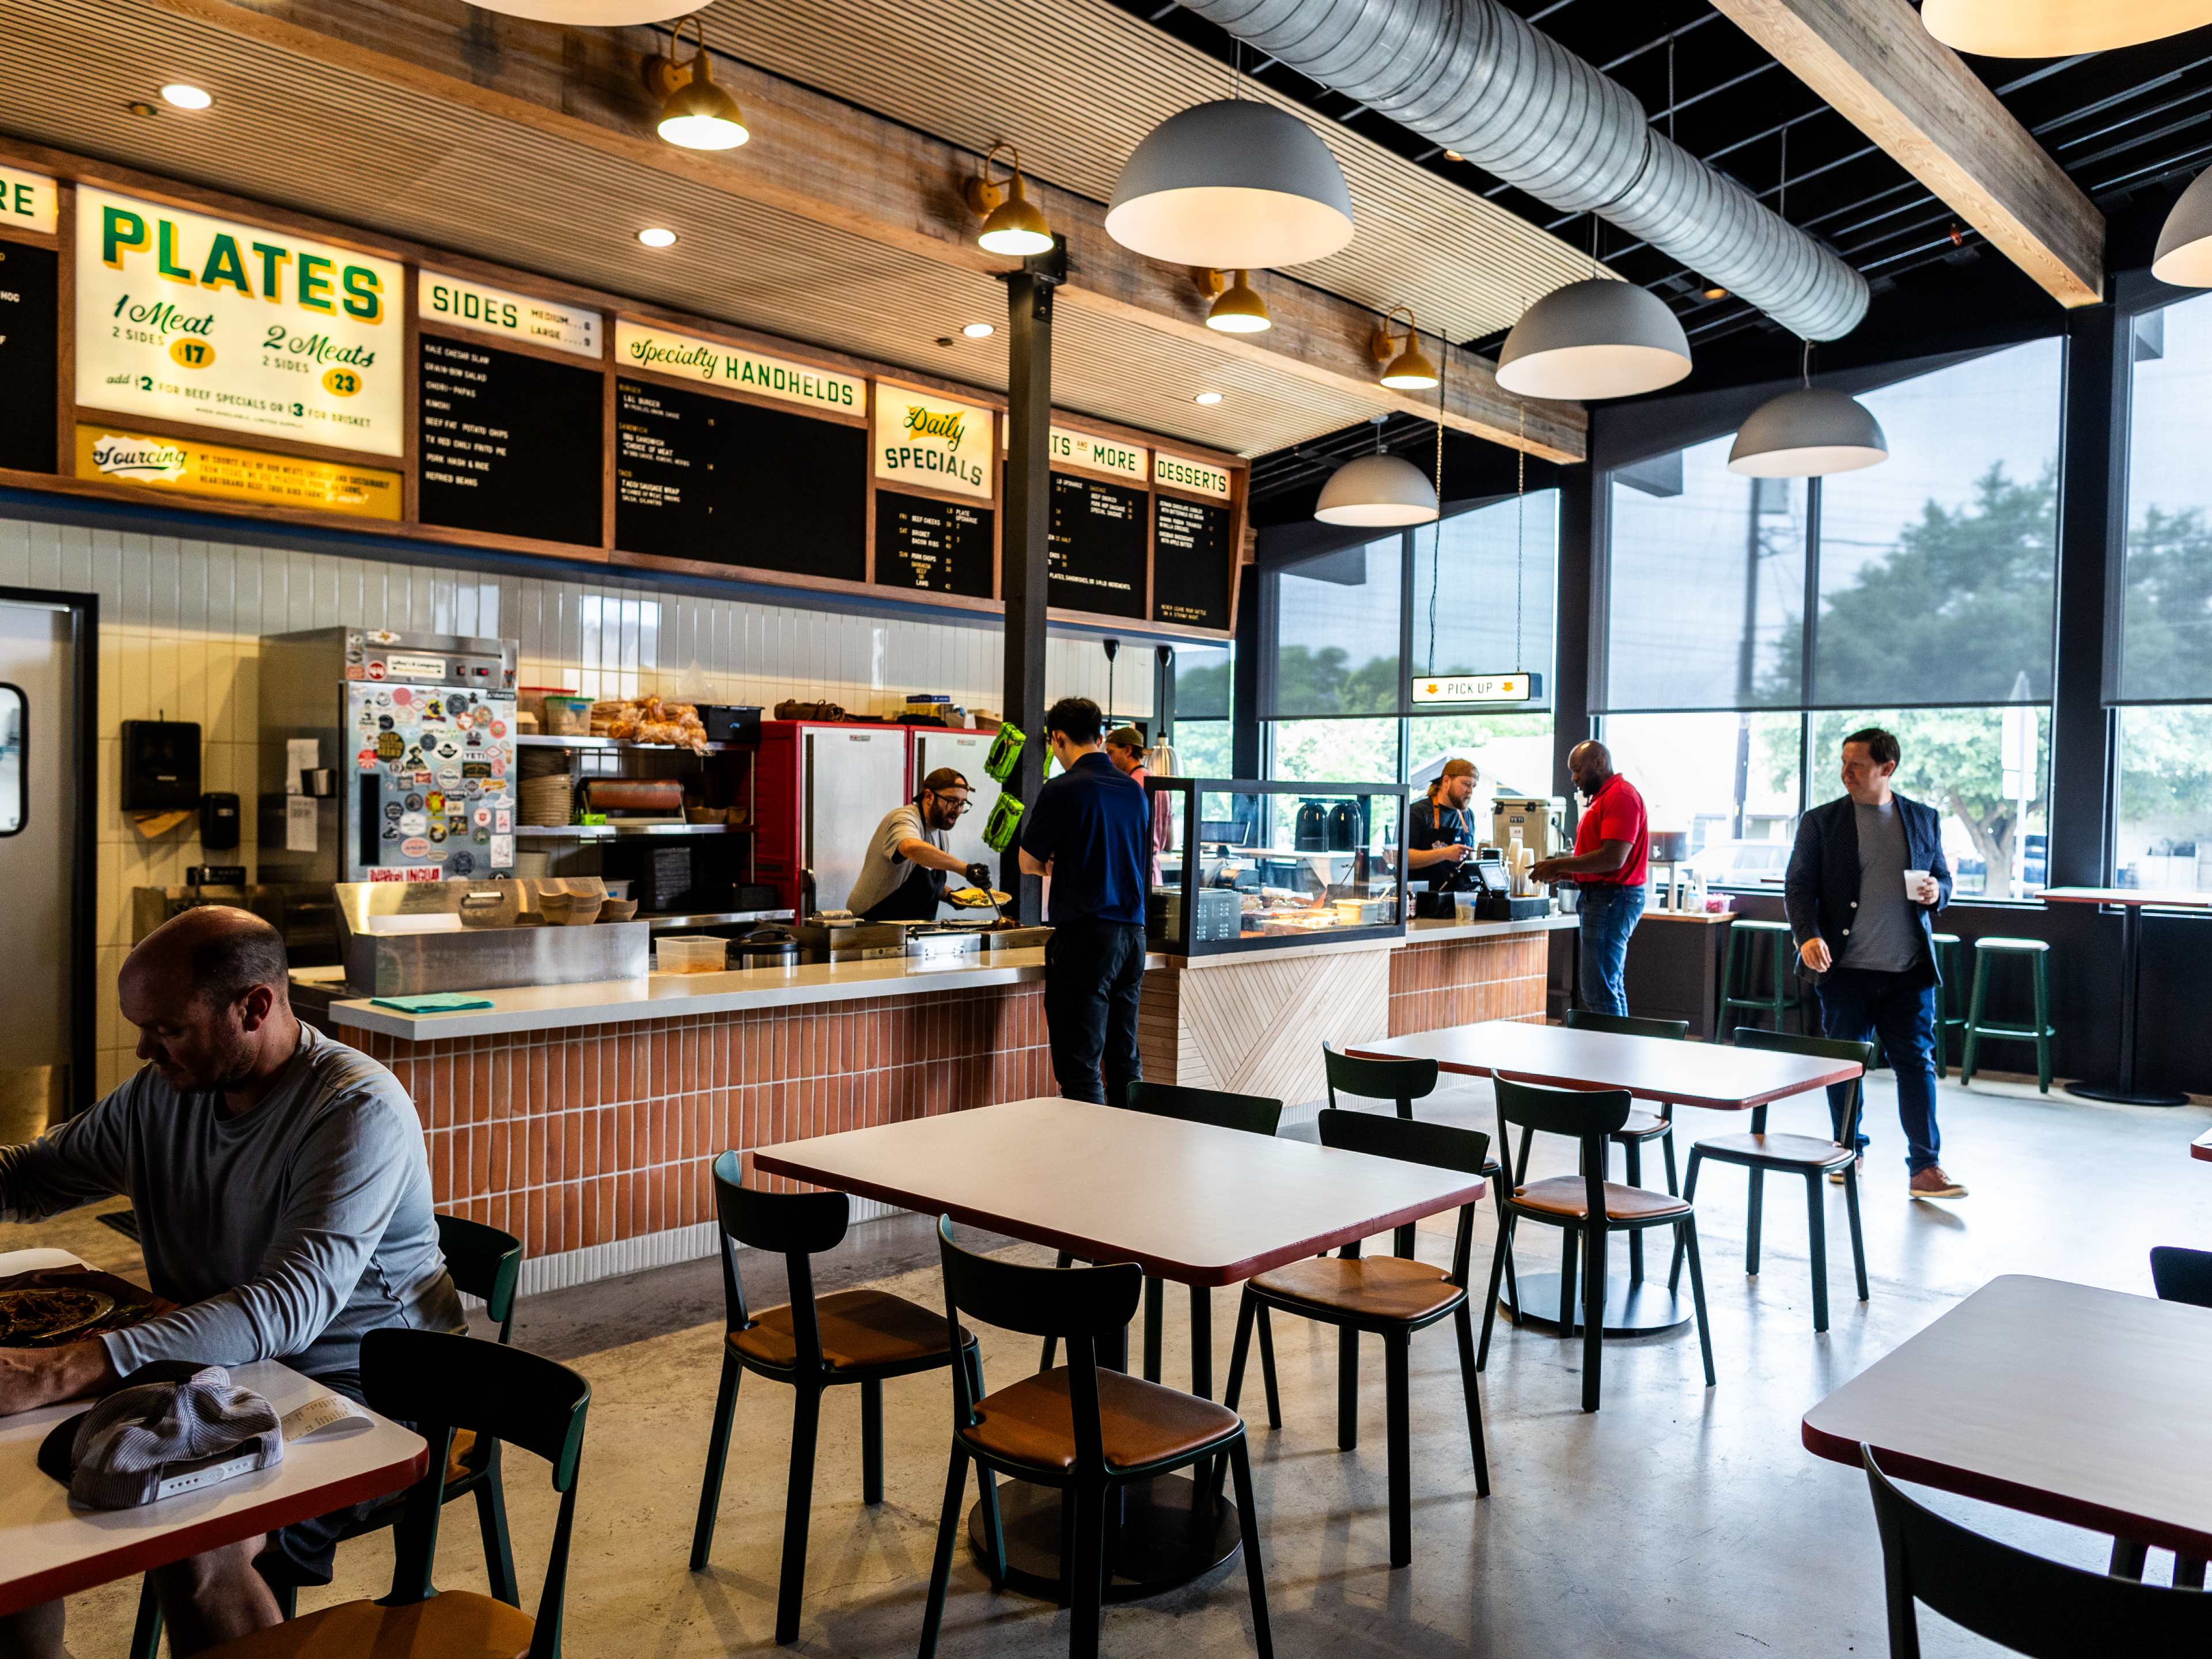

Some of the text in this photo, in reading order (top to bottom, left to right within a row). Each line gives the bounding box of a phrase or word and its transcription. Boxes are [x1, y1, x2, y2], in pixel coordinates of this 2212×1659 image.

[103, 204, 379, 321] PLATES
[113, 294, 214, 335] 1 Meat
[433, 286, 517, 328] SIDES
[531, 309, 568, 324] MEDIUM
[112, 326, 165, 346] 2 SIDES
[531, 325, 560, 339] LARGE
[263, 325, 376, 367] 2 Meats
[425, 344, 442, 355] KALE
[471, 353, 490, 365] SLAW
[263, 355, 309, 373] 2 SIDES
[630, 339, 853, 406] Specialty HANDHELDS
[464, 370, 487, 382] SALAD
[618, 383, 642, 394] BURGER
[106, 374, 131, 384] add
[158, 383, 180, 395] FOR
[184, 387, 210, 400] BEEF
[216, 392, 266, 411] SPECIALS
[270, 402, 283, 414] OR
[308, 408, 327, 421] FOR
[331, 412, 372, 429] BRISKET
[638, 397, 661, 408] BURGER
[425, 416, 444, 427] BEEF
[462, 423, 487, 435] POTATO
[488, 428, 509, 440] CHIPS
[619, 422, 648, 434] SANDWICH
[903, 406, 965, 452] Daily
[437, 436, 451, 447] RED
[474, 443, 493, 454] FRITO
[495, 446, 507, 457] PIE
[636, 435, 665, 447] SANDWICH
[93, 446, 187, 470] Sourcing
[648, 445, 657, 453] OF
[657, 448, 673, 457] MEAT
[1049, 434, 1136, 471] TS AND MORE
[426, 452, 445, 464] PORK
[474, 461, 490, 472] RICE
[885, 447, 983, 486] SPECIALS
[425, 471, 478, 487] REFRIED BEANS
[1157, 461, 1226, 493] DESSERTS
[664, 486, 681, 496] WRAP
[911, 515, 923, 523] BEEF
[923, 517, 941, 526] CHEEKS
[956, 509, 970, 517] PLATE
[911, 529, 931, 538] BRISKET
[911, 537, 927, 546] BACON
[928, 540, 940, 548] RIBS
[911, 552, 922, 560] PORK
[922, 554, 937, 562] CHOPS
[1448, 682, 1493, 694] PICK UP
